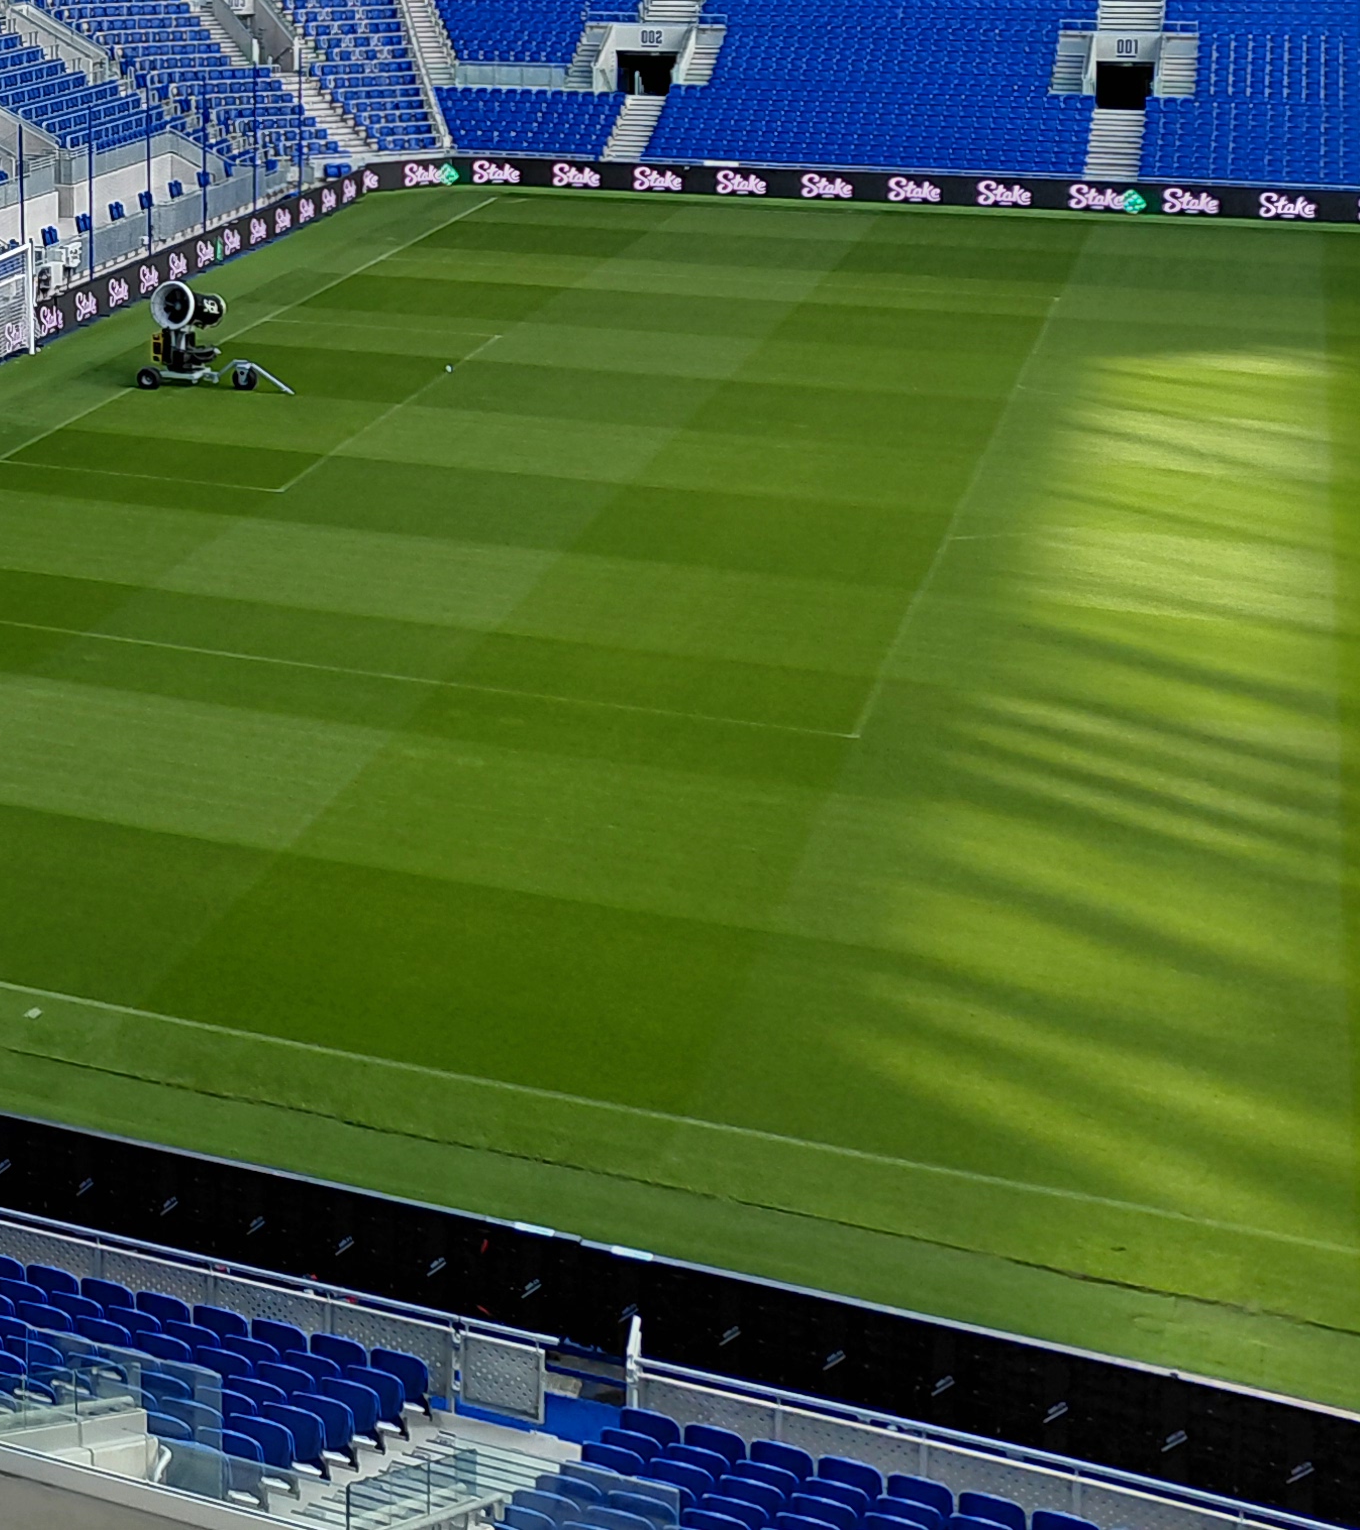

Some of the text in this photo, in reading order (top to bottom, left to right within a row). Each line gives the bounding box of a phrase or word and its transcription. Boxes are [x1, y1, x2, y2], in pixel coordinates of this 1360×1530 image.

[641, 30, 663, 44] 002
[1117, 39, 1138, 53] 001
[473, 161, 520, 183] Stake
[553, 164, 600, 186] Stake
[634, 167, 682, 190] Stake
[717, 170, 767, 195] Stake
[802, 174, 852, 198] Stake
[888, 177, 941, 202] Stake
[978, 181, 1031, 206] Stake
[1069, 185, 1123, 210] Stake
[1163, 189, 1219, 214] Stake
[1260, 193, 1316, 219] Stake
